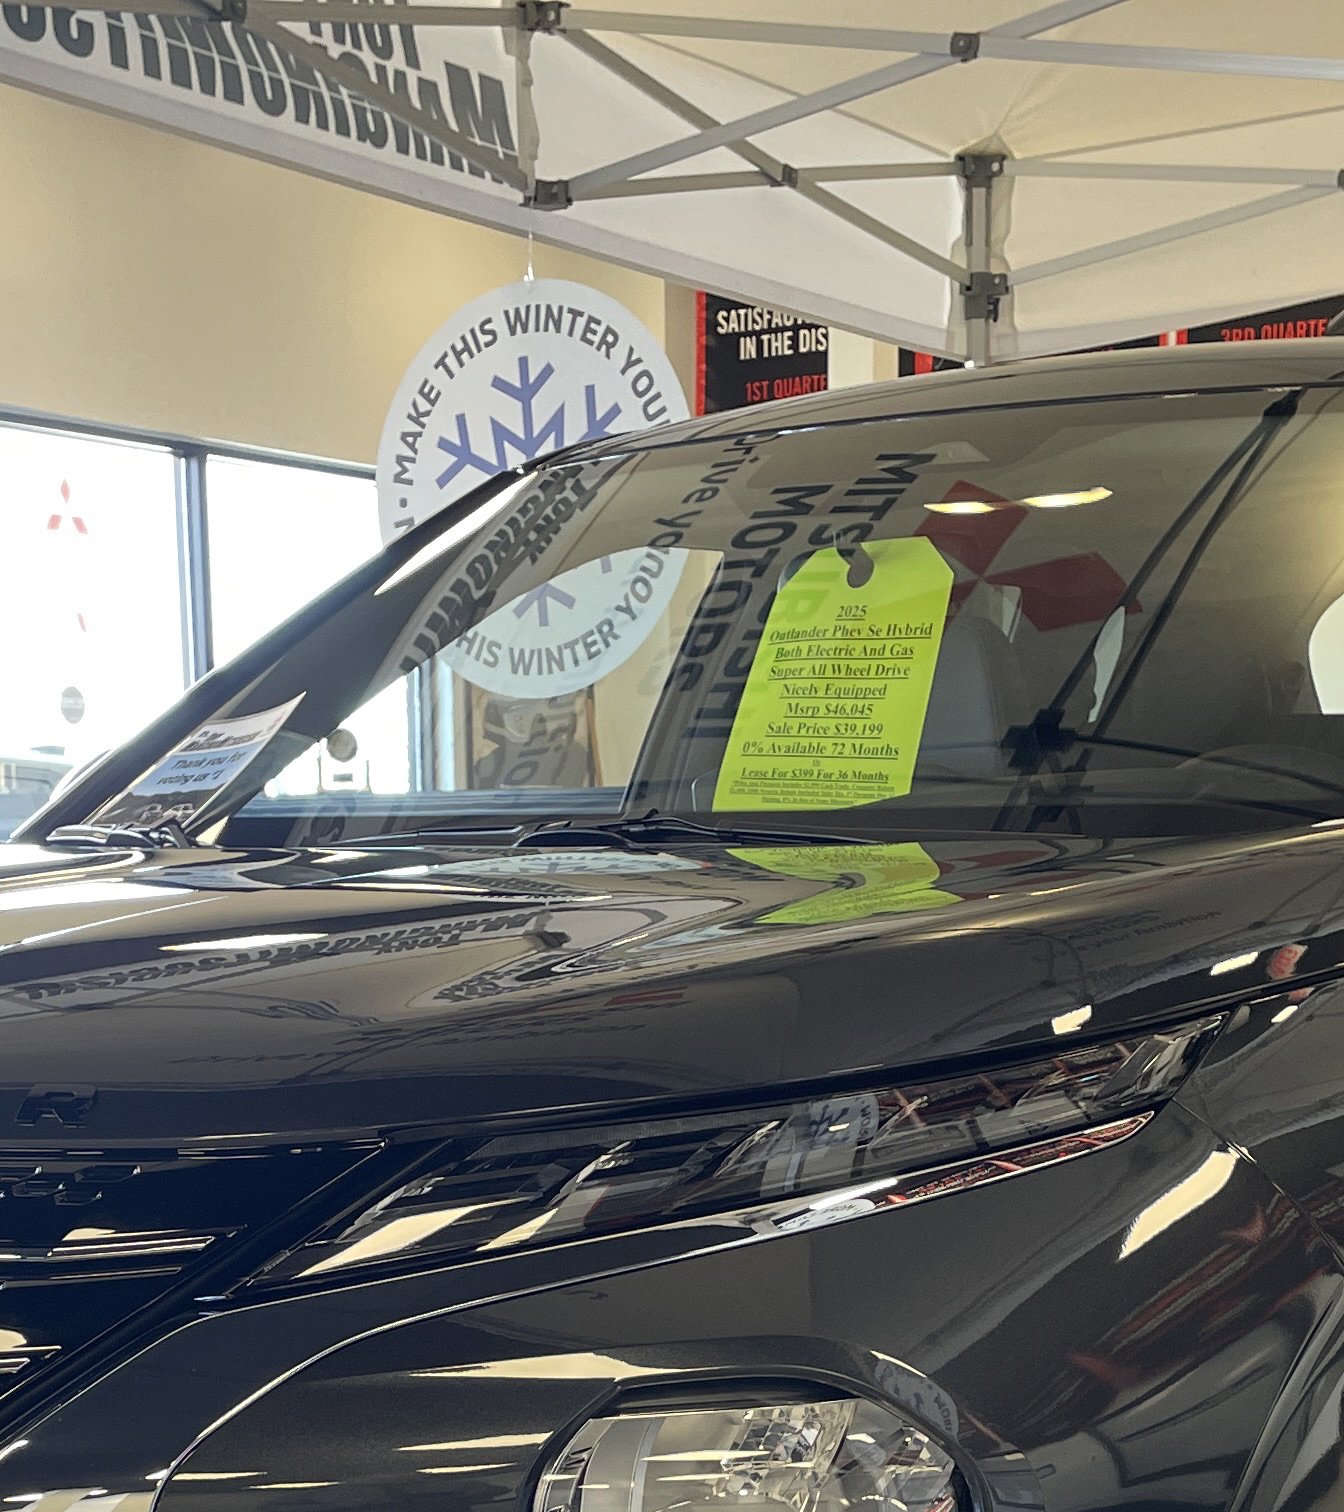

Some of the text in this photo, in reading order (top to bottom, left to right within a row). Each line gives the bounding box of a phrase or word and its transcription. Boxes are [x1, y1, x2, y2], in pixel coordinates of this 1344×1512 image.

[716, 305, 808, 335] SATISFAC
[739, 326, 828, 361] IN THE DIS
[392, 303, 673, 486] MAKE THIS WINTER YOU
[745, 380, 770, 402] 1ST
[836, 605, 868, 619] 2025
[769, 626, 829, 643] Outlander
[831, 625, 862, 638] Phev
[868, 625, 883, 638] Se
[454, 630, 503, 669] HIS
[508, 617, 622, 677] WINTER
[775, 643, 915, 659] Both Electric And Gas
[769, 663, 911, 679] Super All Wheel Drive
[782, 683, 887, 698] Nicely Equipped
[785, 703, 821, 717] Msrp
[766, 722, 794, 735] Sale
[797, 722, 831, 736] Price
[767, 742, 828, 756] Available
[830, 743, 846, 756] 72
[848, 743, 900, 757] Months
